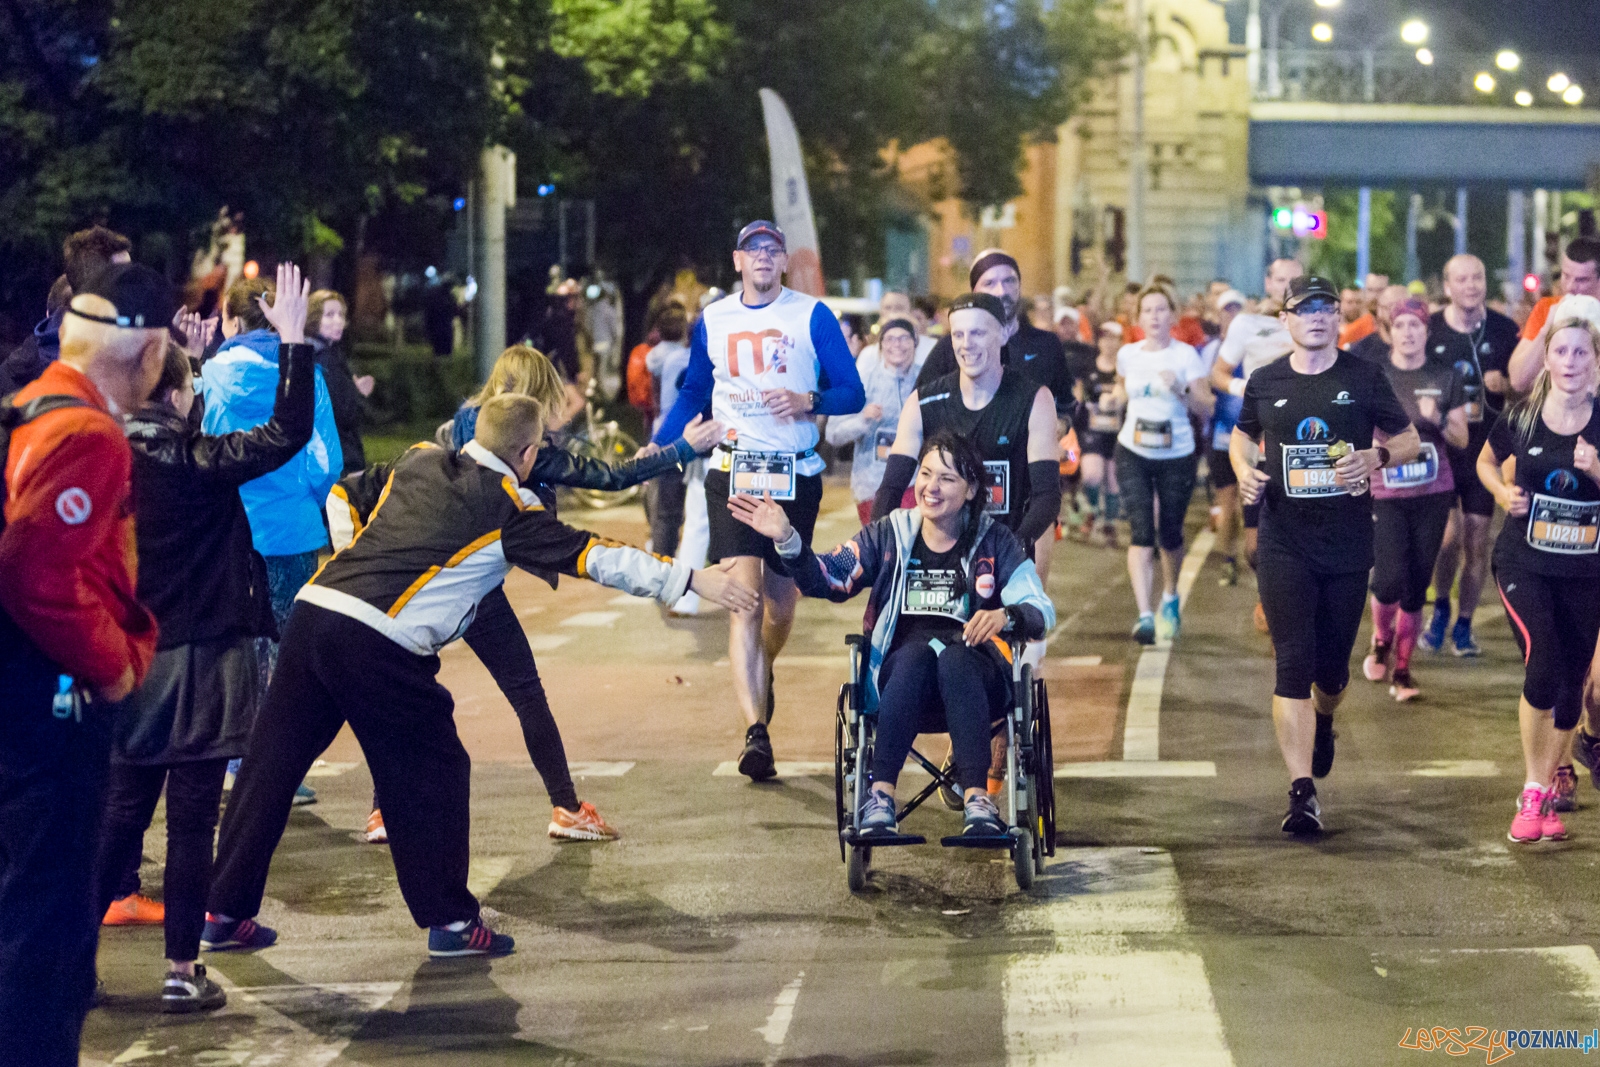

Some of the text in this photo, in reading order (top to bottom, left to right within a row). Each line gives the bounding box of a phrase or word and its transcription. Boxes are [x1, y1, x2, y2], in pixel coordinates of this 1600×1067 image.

[750, 474, 773, 488] 401
[1303, 470, 1336, 486] 1942
[1546, 523, 1587, 543] 10281
